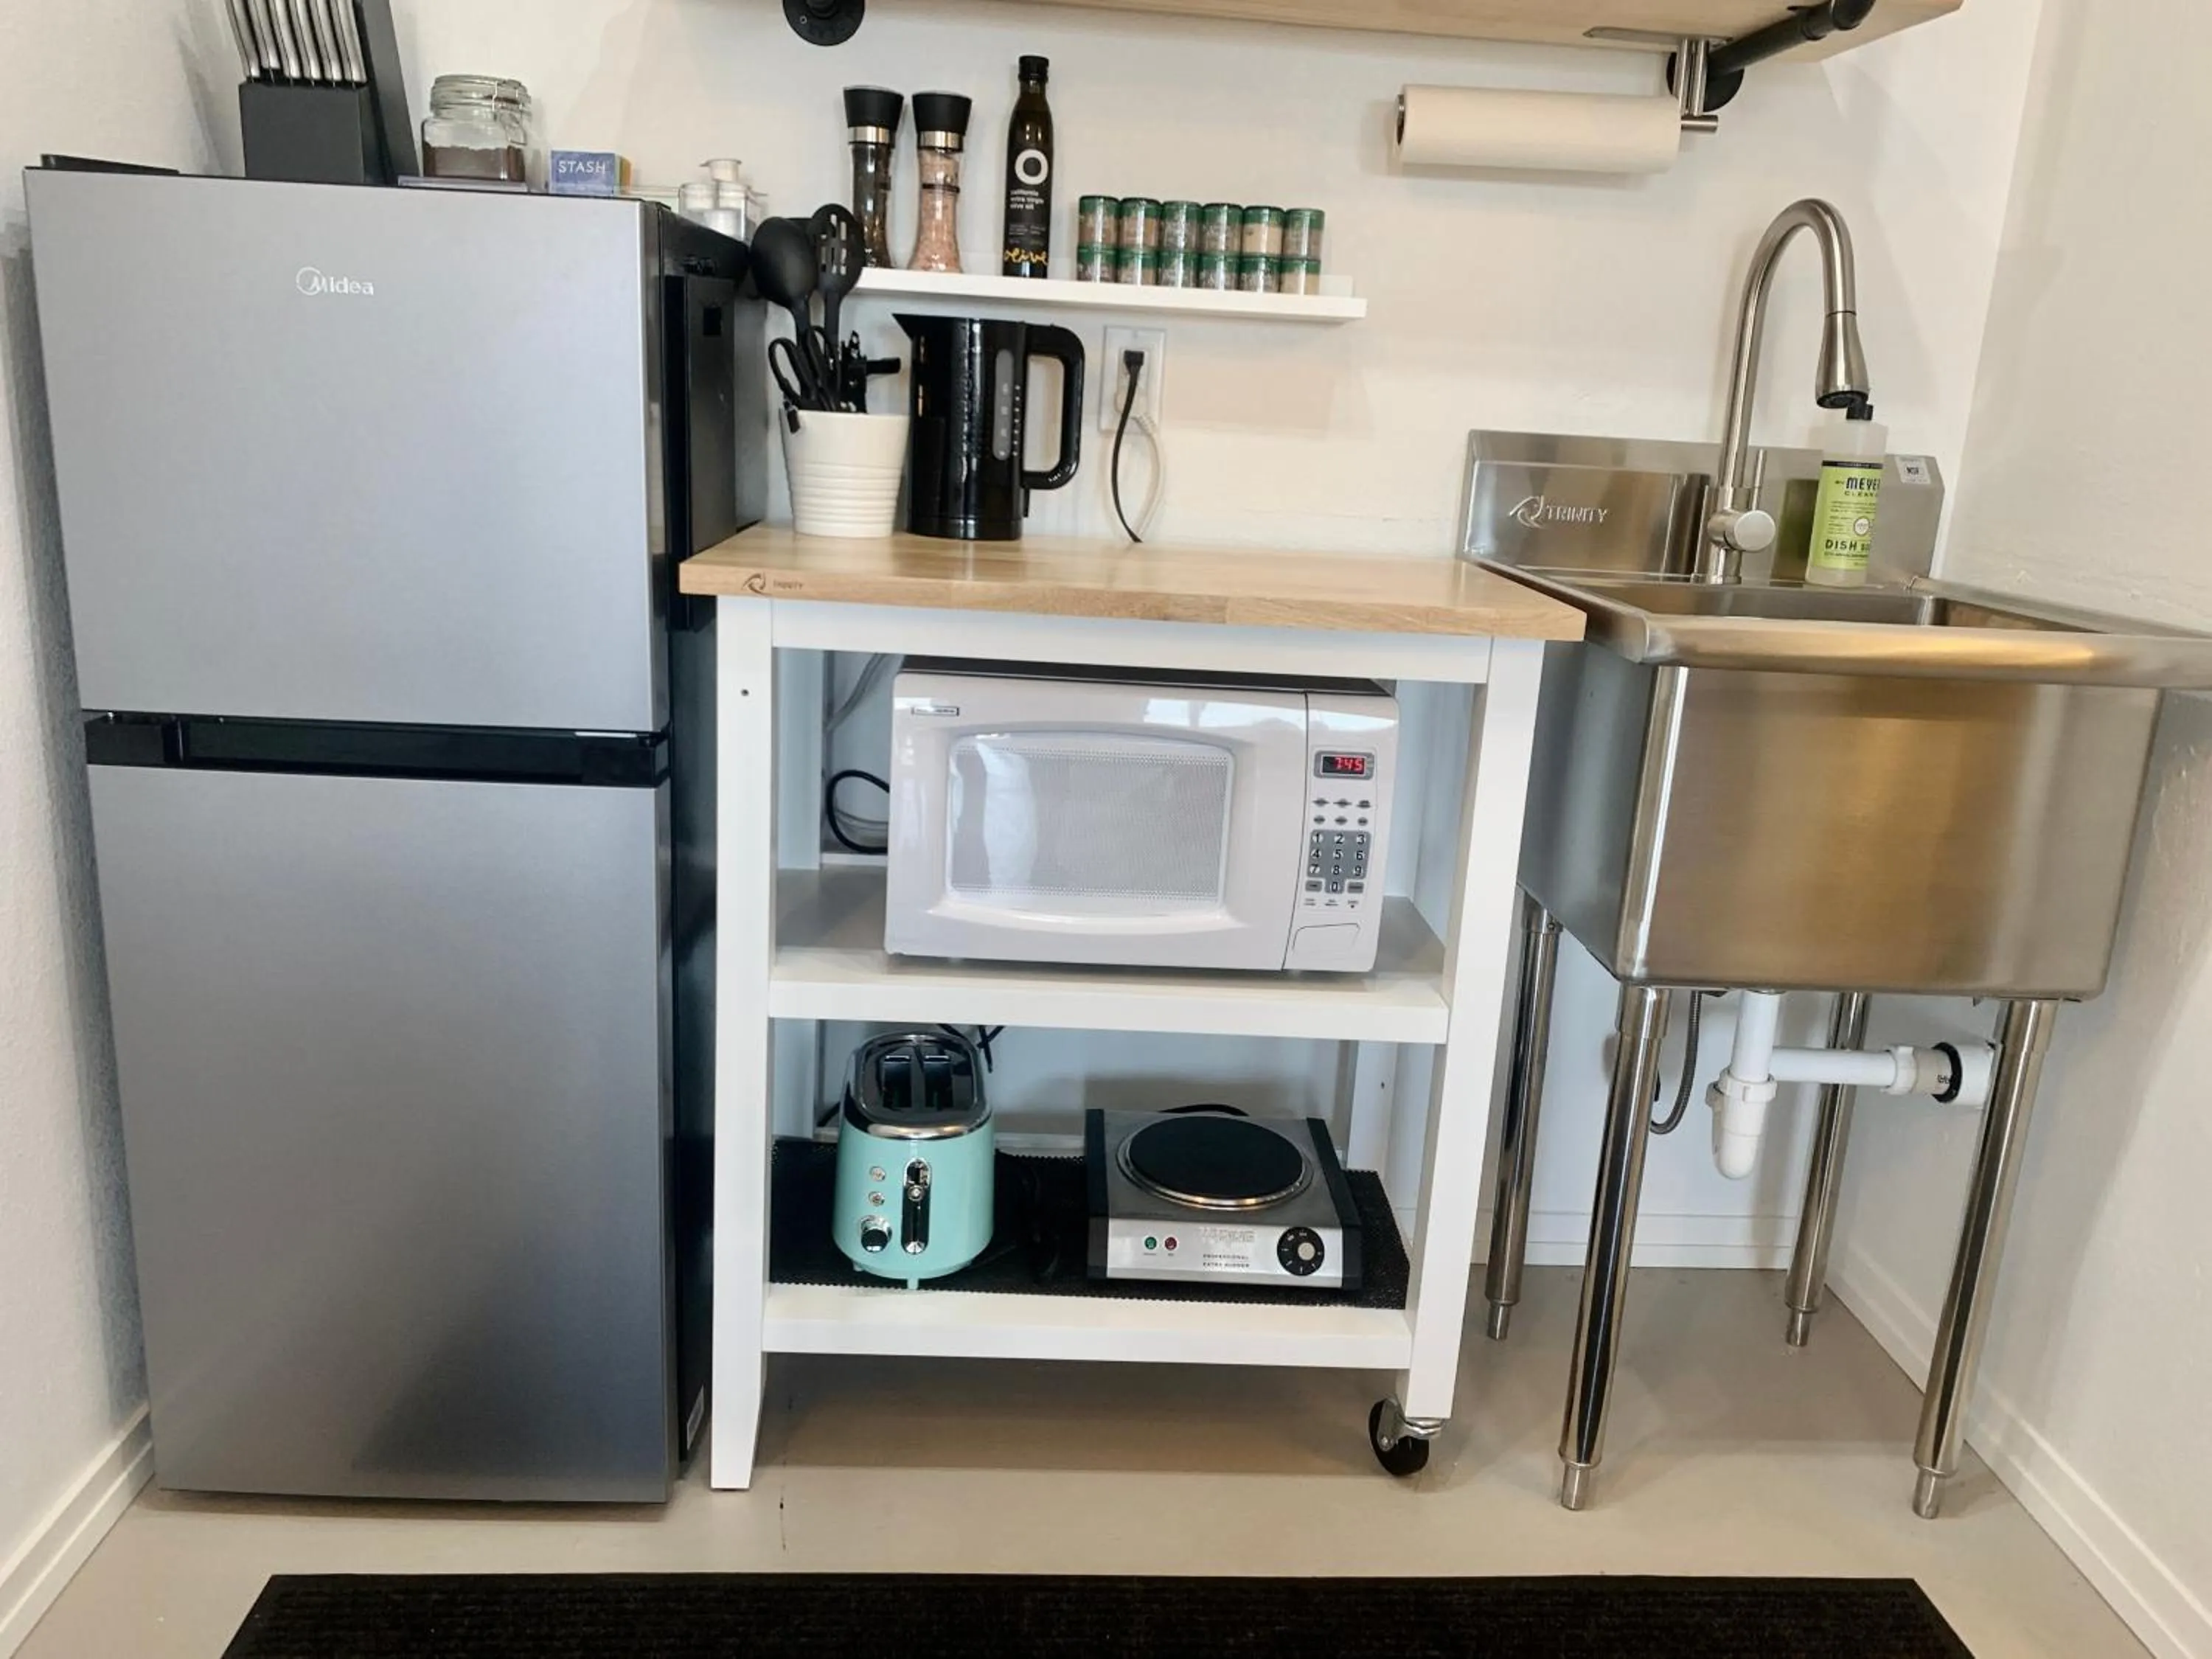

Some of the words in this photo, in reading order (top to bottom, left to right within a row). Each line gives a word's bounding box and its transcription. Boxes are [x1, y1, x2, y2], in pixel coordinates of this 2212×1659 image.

[558, 160, 605, 174] STASH
[296, 266, 374, 296] Midea
[1545, 505, 1609, 524] TRINITY
[1825, 539, 1857, 552] DISH
[1315, 833, 1320, 843] 1
[1335, 834, 1343, 844] 2
[1357, 834, 1364, 844] 3
[1312, 850, 1320, 859] 4
[1335, 850, 1342, 860] 5
[1356, 851, 1363, 860] 6
[1310, 865, 1318, 874] 7
[1333, 866, 1340, 875] 8
[1354, 866, 1361, 877] 9
[1331, 882, 1338, 892] 0
